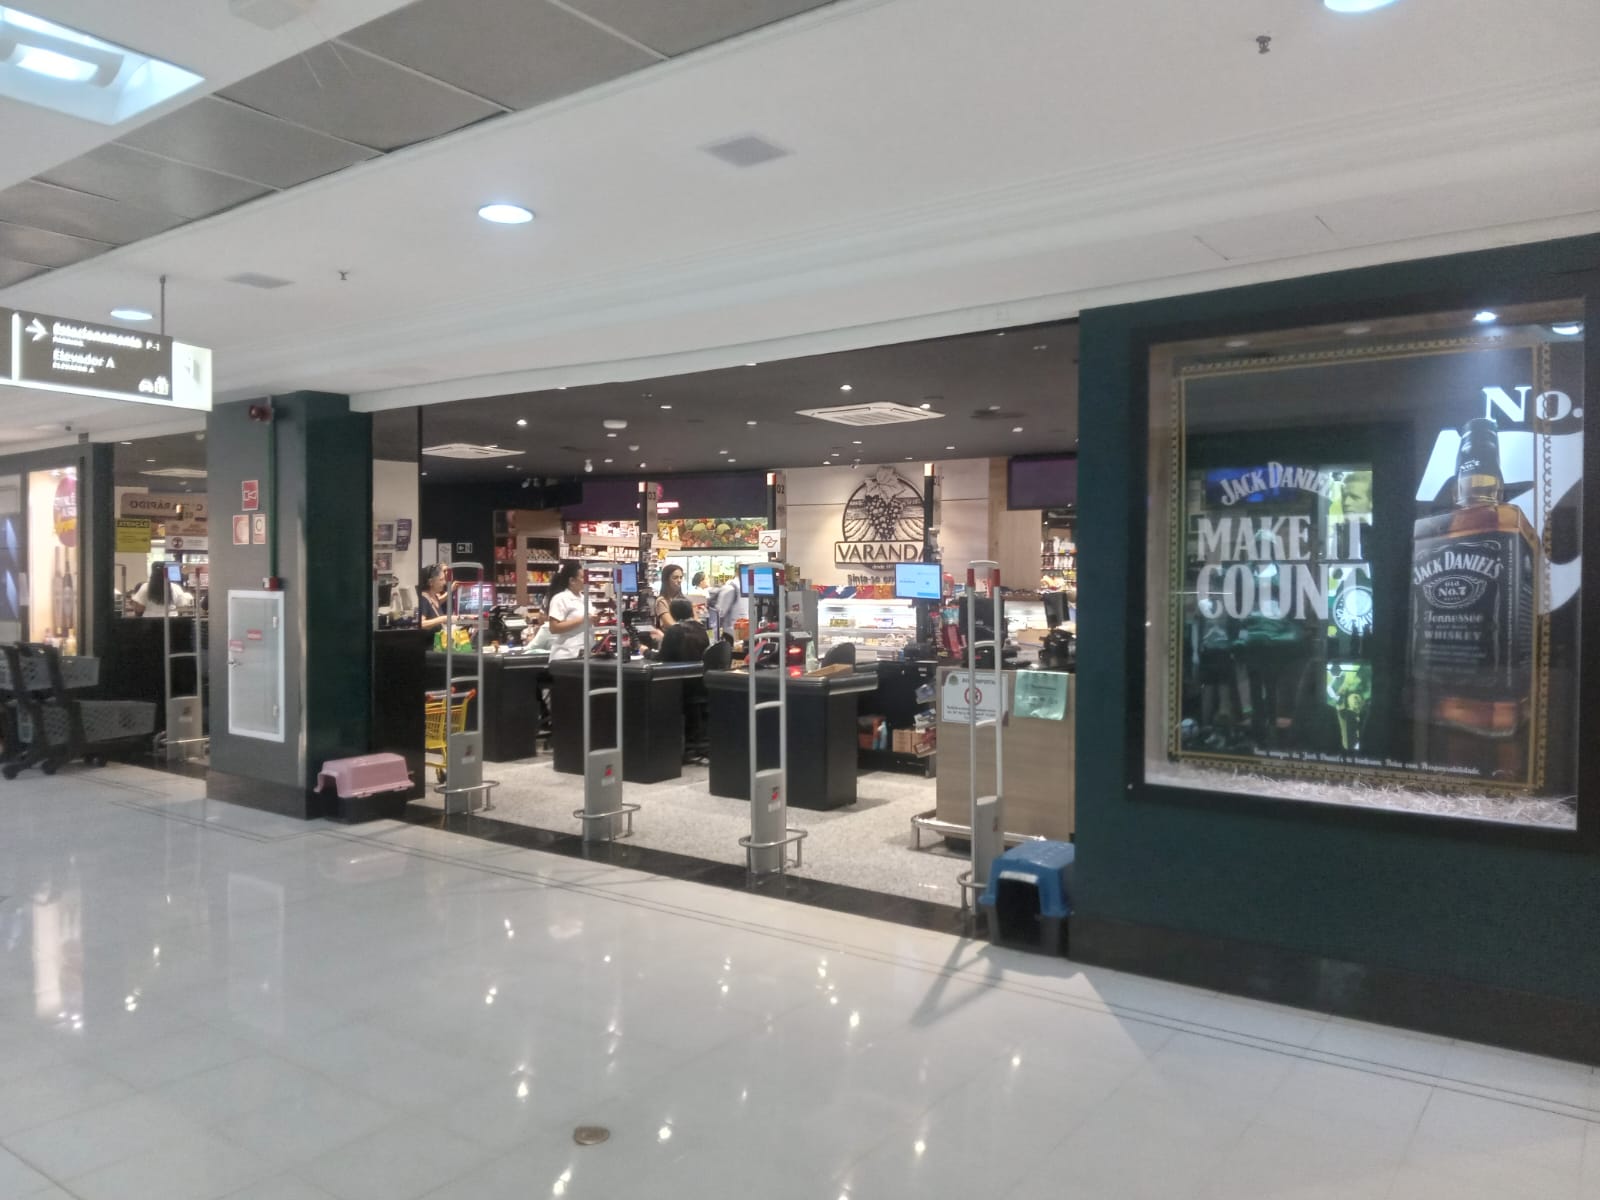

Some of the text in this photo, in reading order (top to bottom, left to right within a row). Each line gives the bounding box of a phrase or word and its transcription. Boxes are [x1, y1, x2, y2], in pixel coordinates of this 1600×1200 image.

[1482, 386, 1584, 423] No.
[1220, 470, 1267, 506] JACK
[1196, 513, 1373, 561] MAKE IT
[1413, 551, 1504, 585] JACK DANIEL'S
[1196, 562, 1372, 620] COUNT
[1424, 631, 1482, 640] WHISKEY
